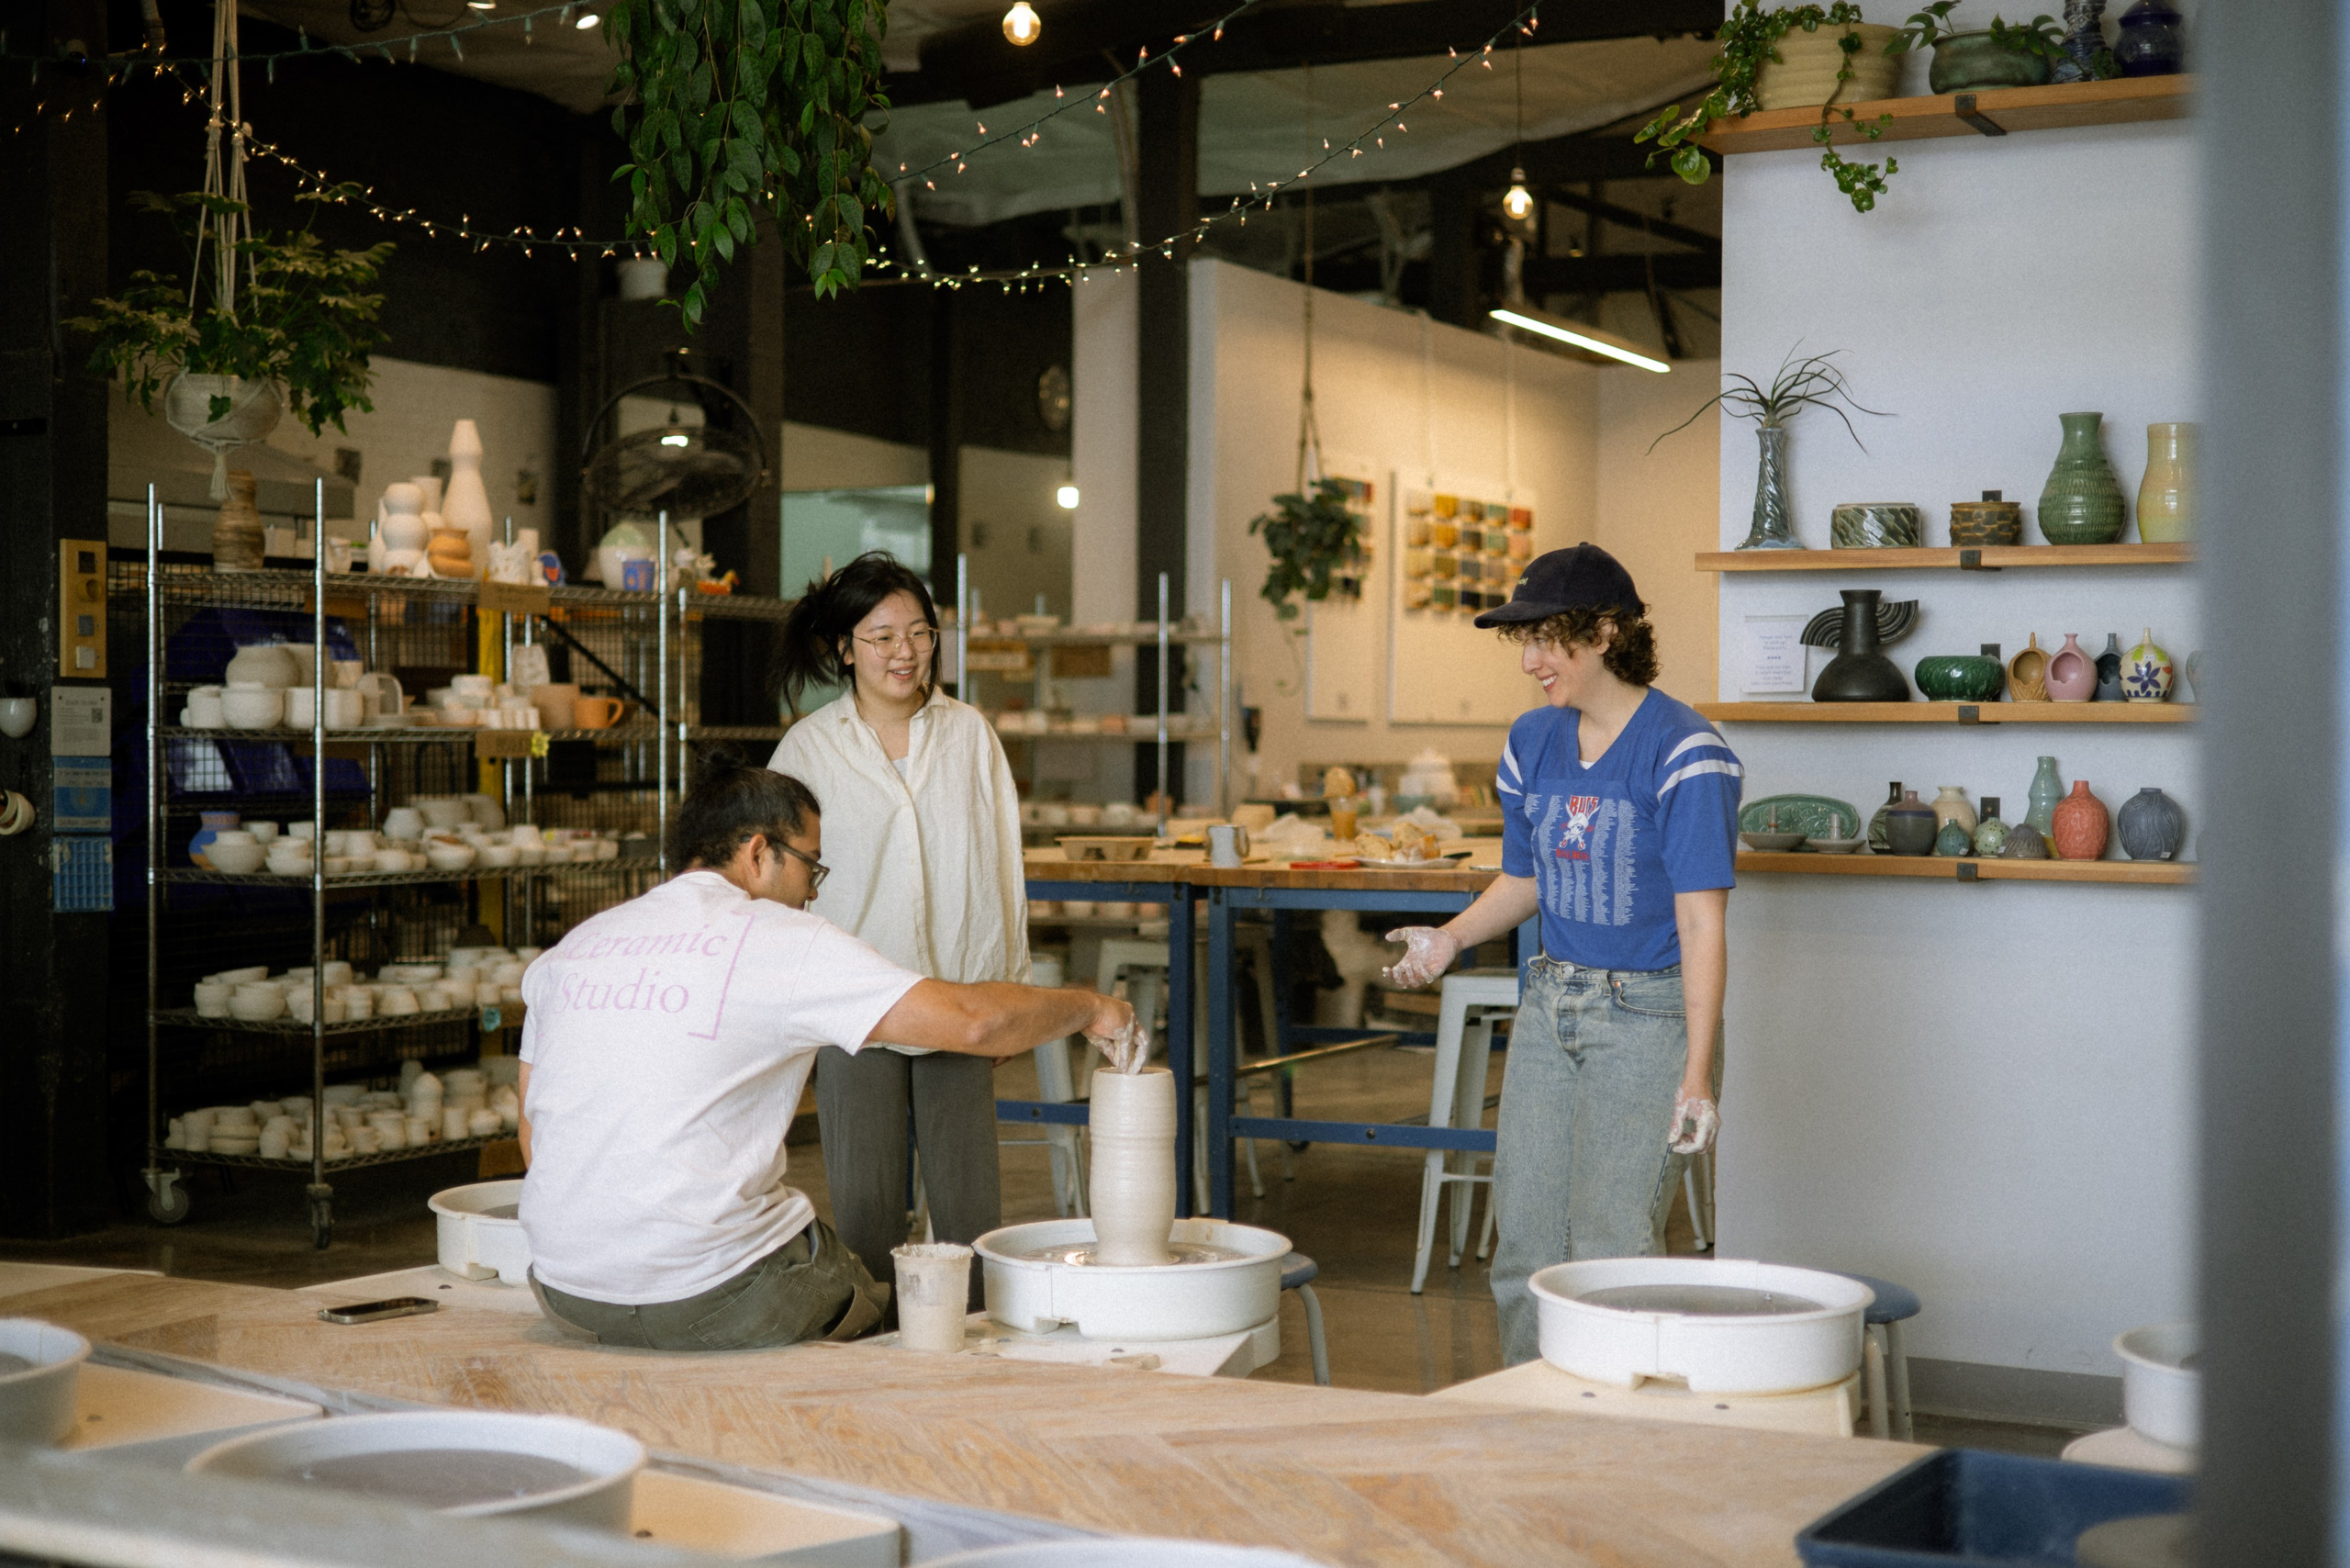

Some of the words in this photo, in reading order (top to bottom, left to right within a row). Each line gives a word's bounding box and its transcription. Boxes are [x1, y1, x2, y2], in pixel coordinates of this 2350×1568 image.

[1569, 795, 1600, 818] BUCS
[566, 924, 728, 960] Ceramic
[553, 967, 689, 1014] Studio
